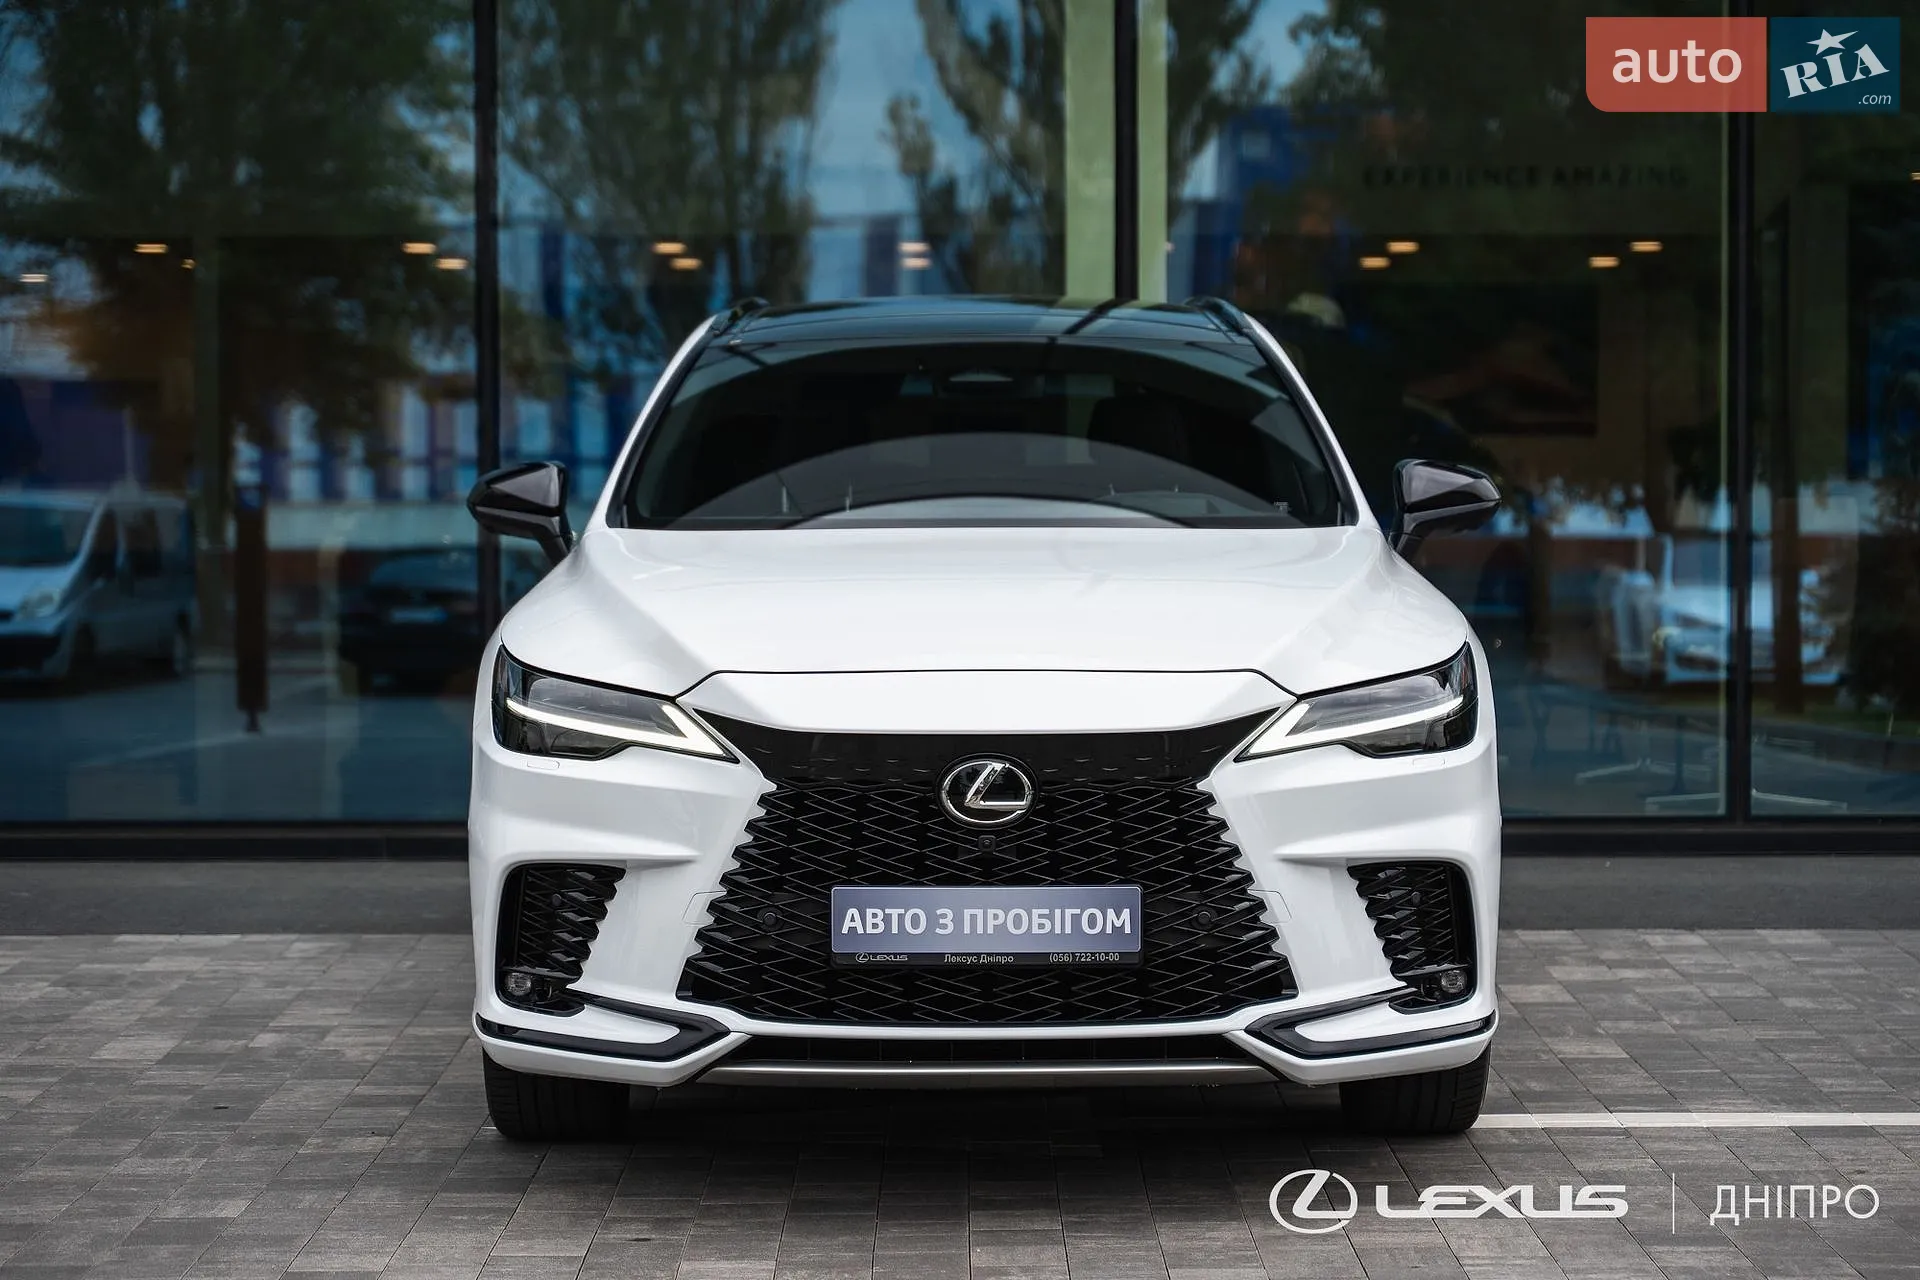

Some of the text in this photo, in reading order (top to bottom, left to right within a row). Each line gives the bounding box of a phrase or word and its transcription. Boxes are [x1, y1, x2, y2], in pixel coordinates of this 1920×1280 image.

[1362, 165, 1689, 188] EXPERIENCE AMAZING
[841, 908, 1132, 935] АВТО З ПРОБІГОМ
[944, 954, 1014, 965] Лексус Дніпро
[1049, 953, 1120, 963] (056) 722-10-00
